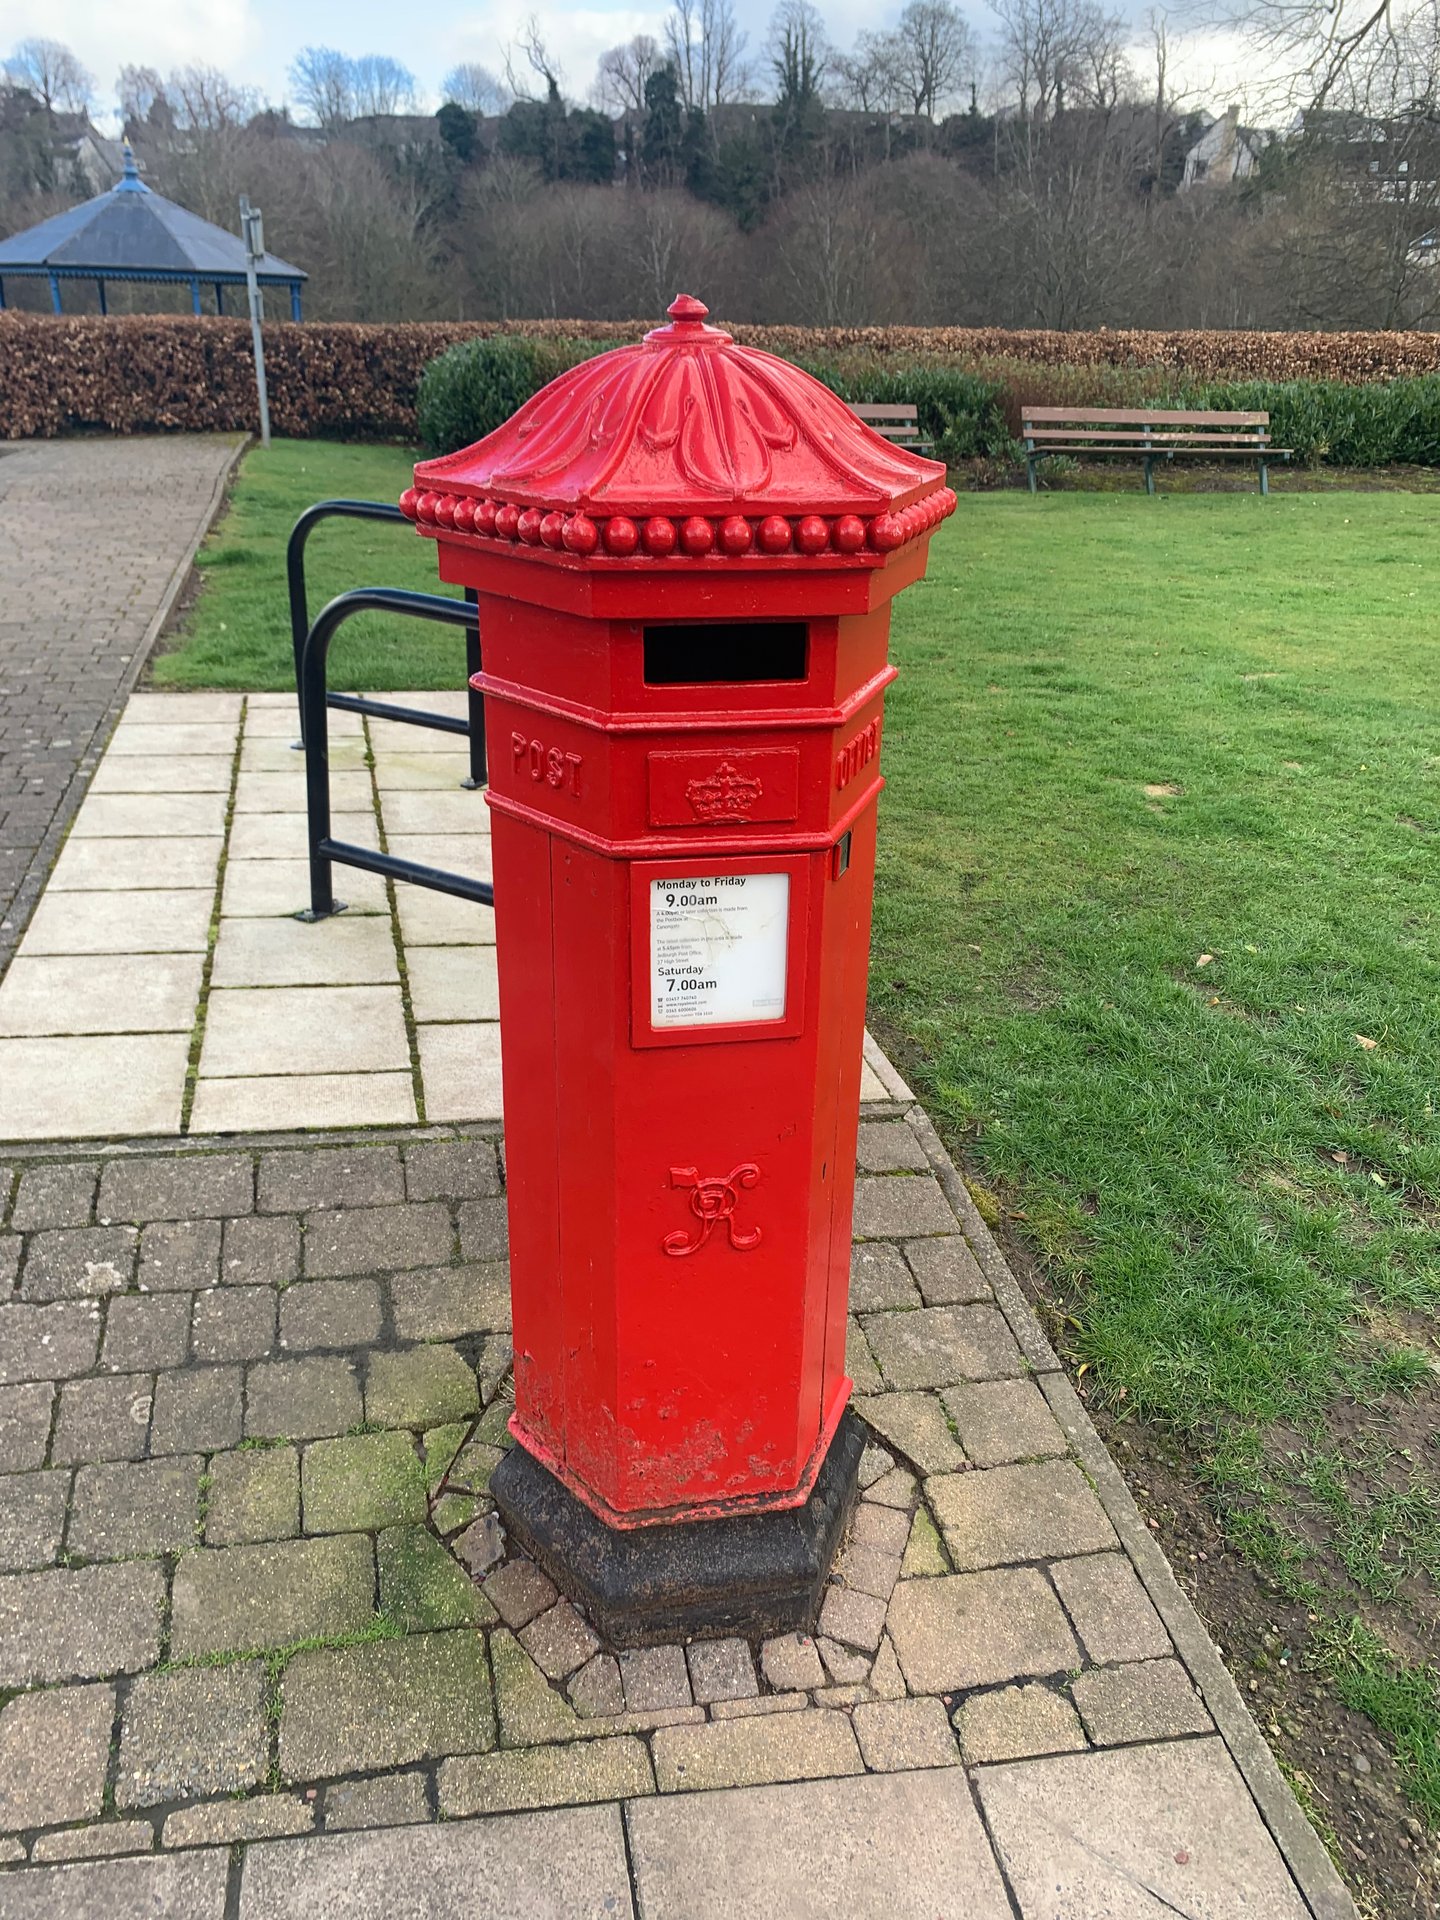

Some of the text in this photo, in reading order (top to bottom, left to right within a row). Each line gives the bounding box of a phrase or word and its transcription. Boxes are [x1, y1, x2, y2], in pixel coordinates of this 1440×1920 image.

[512, 731, 583, 797] POST
[657, 877, 746, 890] Monday to Friday
[666, 893, 717, 907] 9.00am
[658, 965, 704, 976] Saturday
[666, 978, 717, 992] 7.00am
